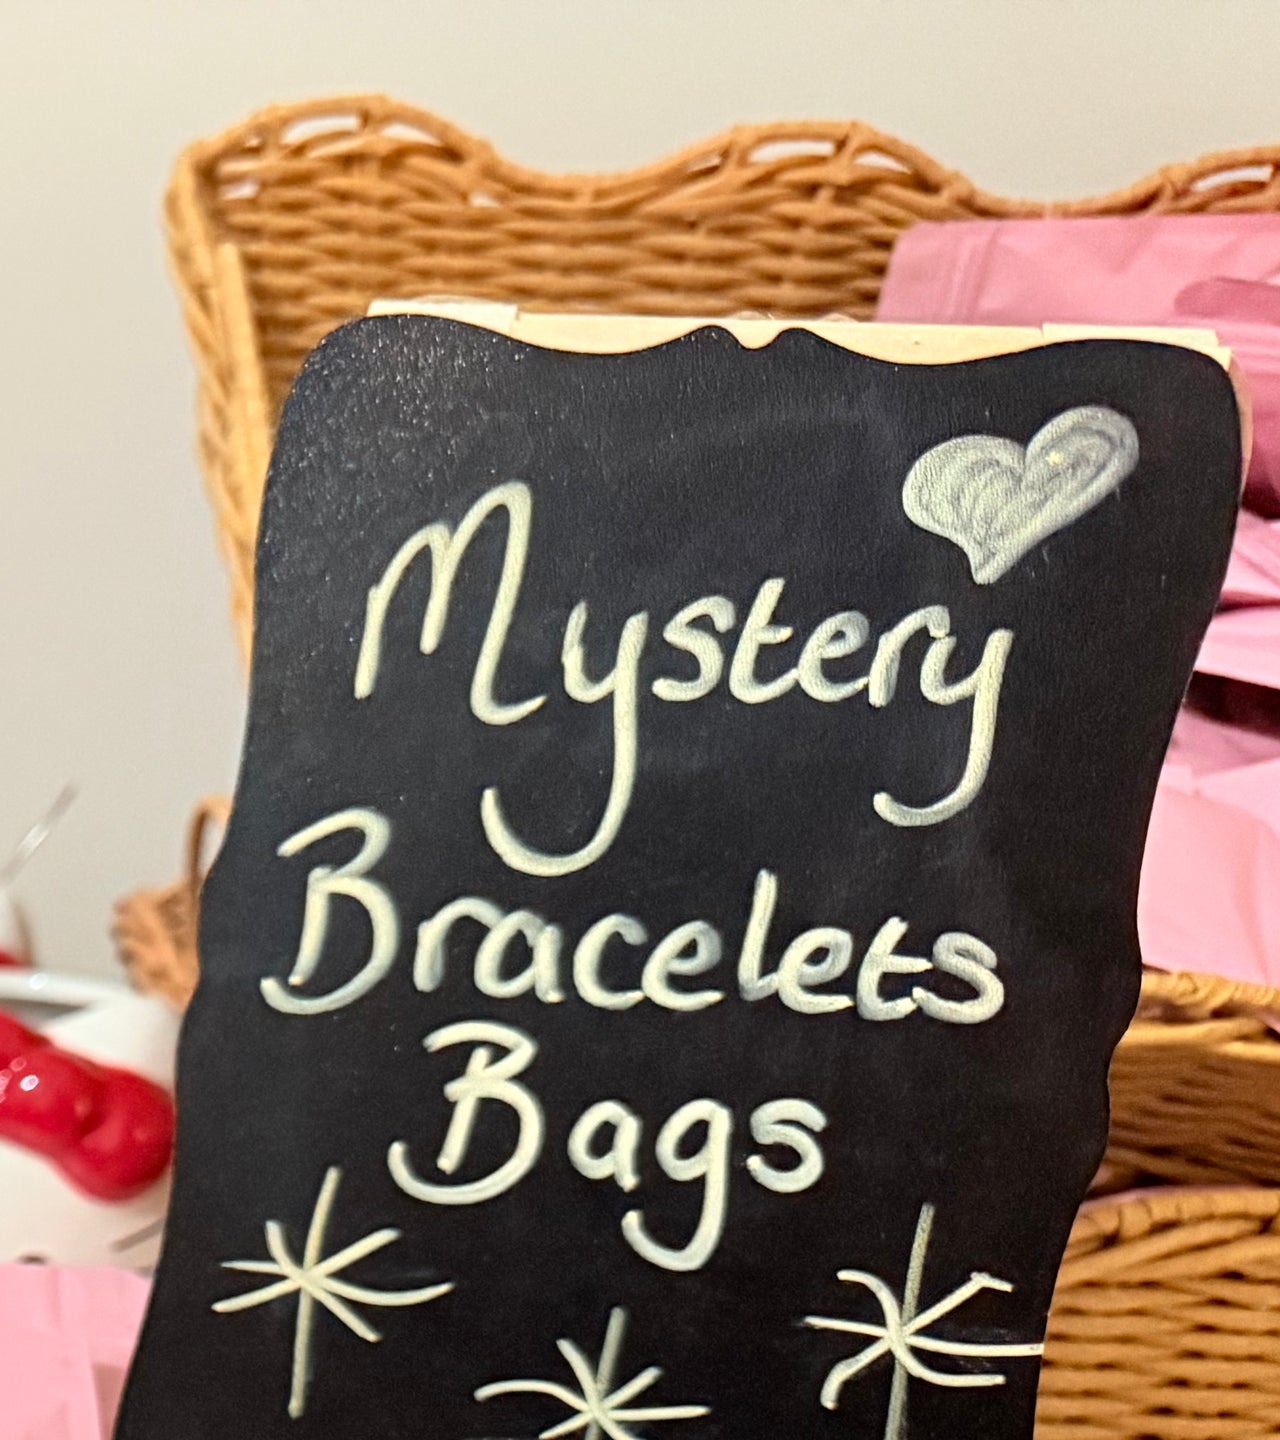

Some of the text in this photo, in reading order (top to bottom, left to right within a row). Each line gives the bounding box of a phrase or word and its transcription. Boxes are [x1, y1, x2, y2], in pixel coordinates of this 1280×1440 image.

[352, 478, 1015, 878] Mystery
[258, 806, 1008, 1024] Bracelets
[385, 1020, 829, 1273] Bags
